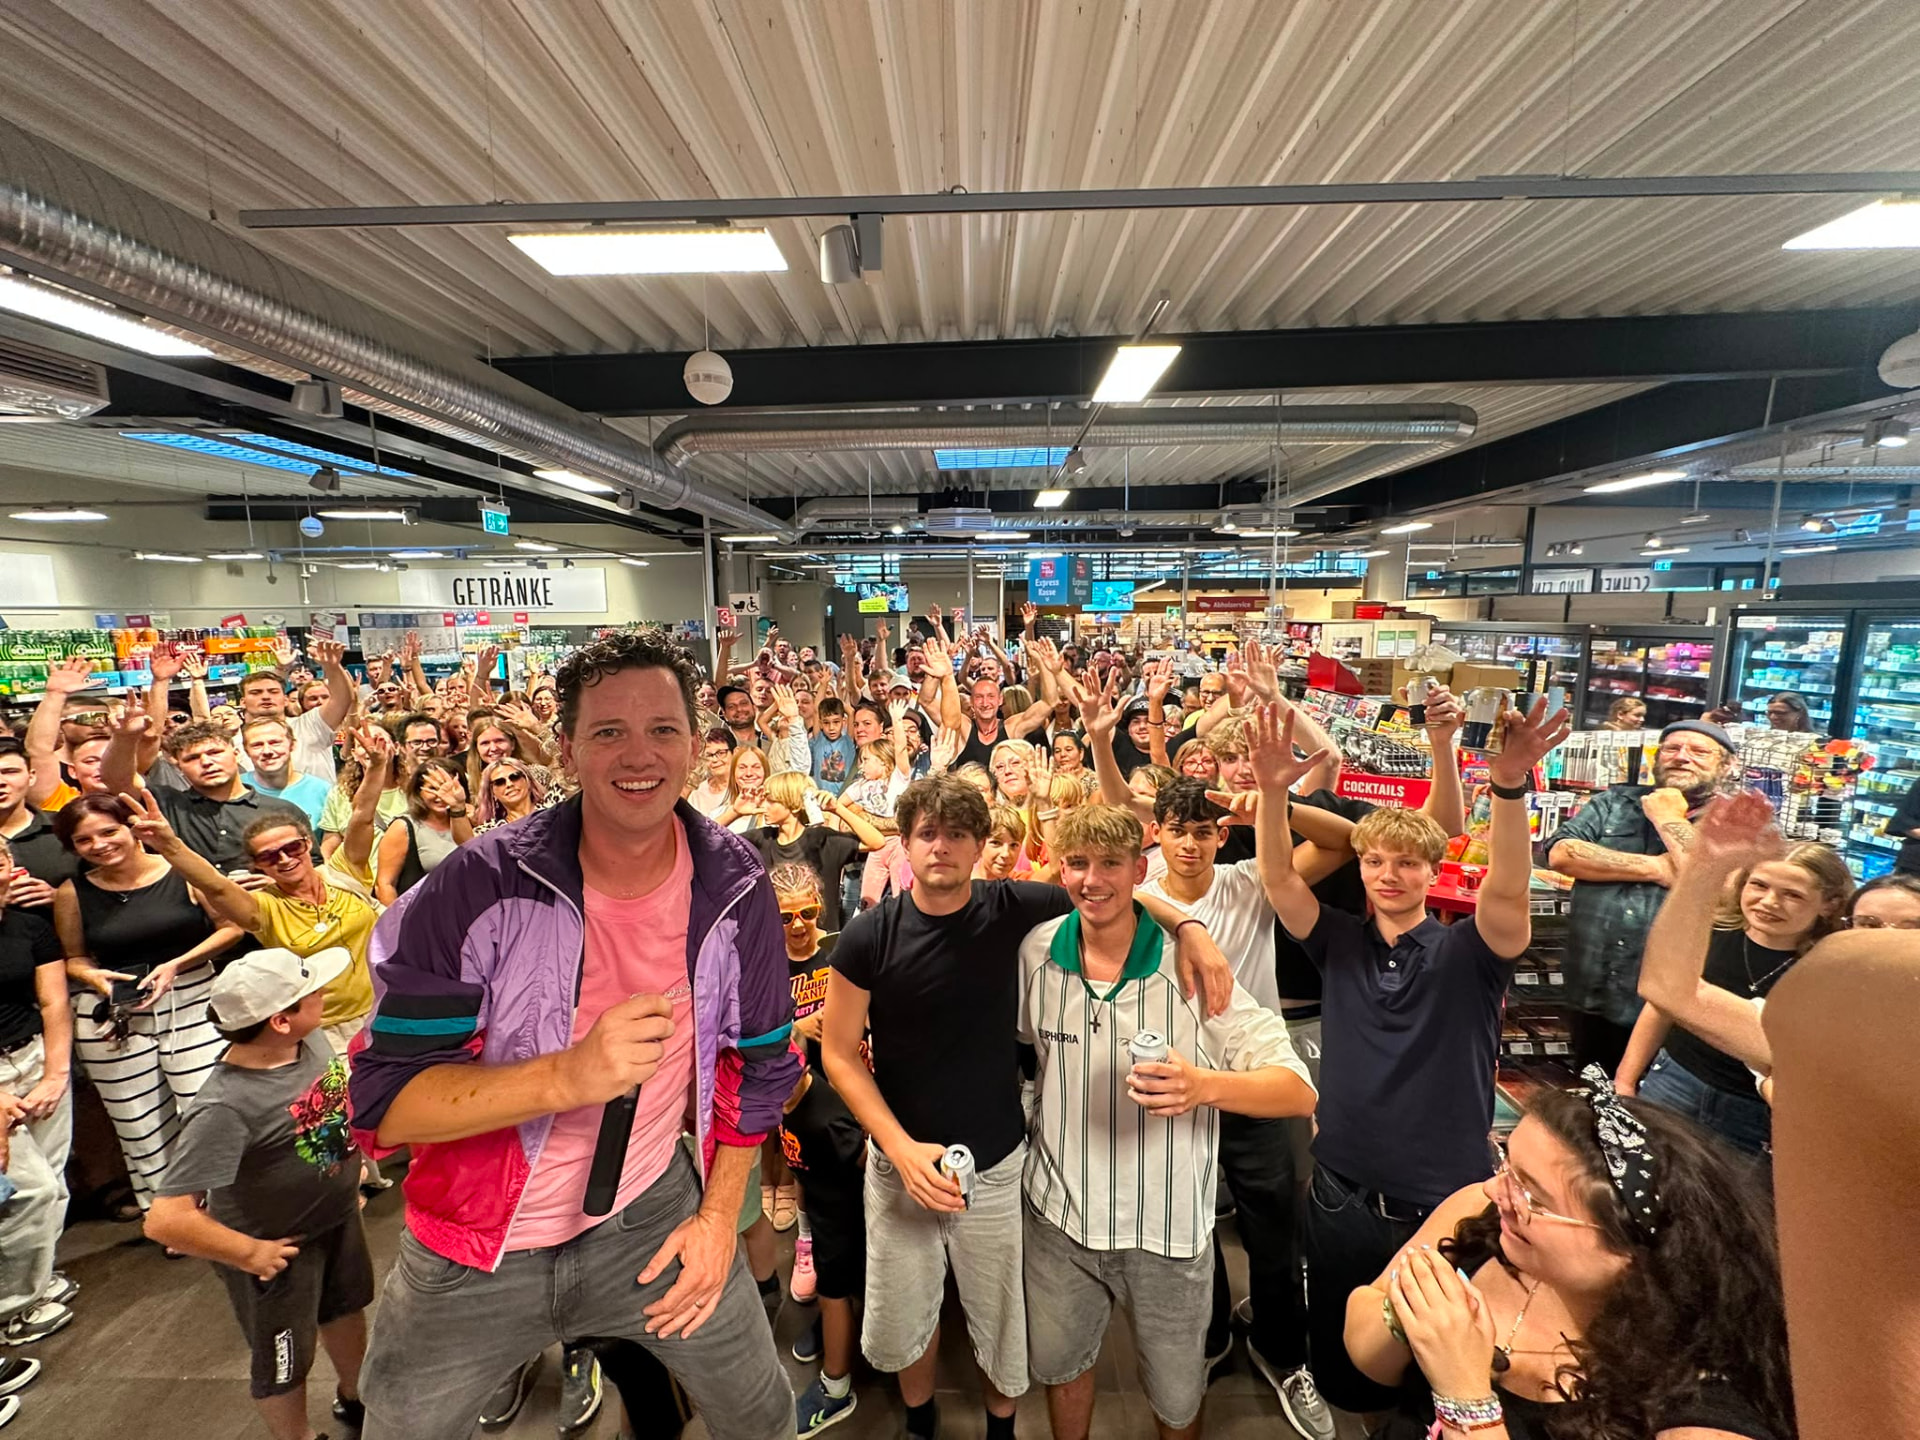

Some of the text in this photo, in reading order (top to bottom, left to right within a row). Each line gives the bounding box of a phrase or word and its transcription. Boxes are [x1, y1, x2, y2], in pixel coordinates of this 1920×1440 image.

[453, 571, 554, 606] GETRÄNKE
[1035, 579, 1060, 588] Express
[1038, 588, 1057, 597] Kasse
[720, 611, 730, 624] 3
[954, 610, 963, 622] 2
[1343, 780, 1405, 797] COCKTAILS
